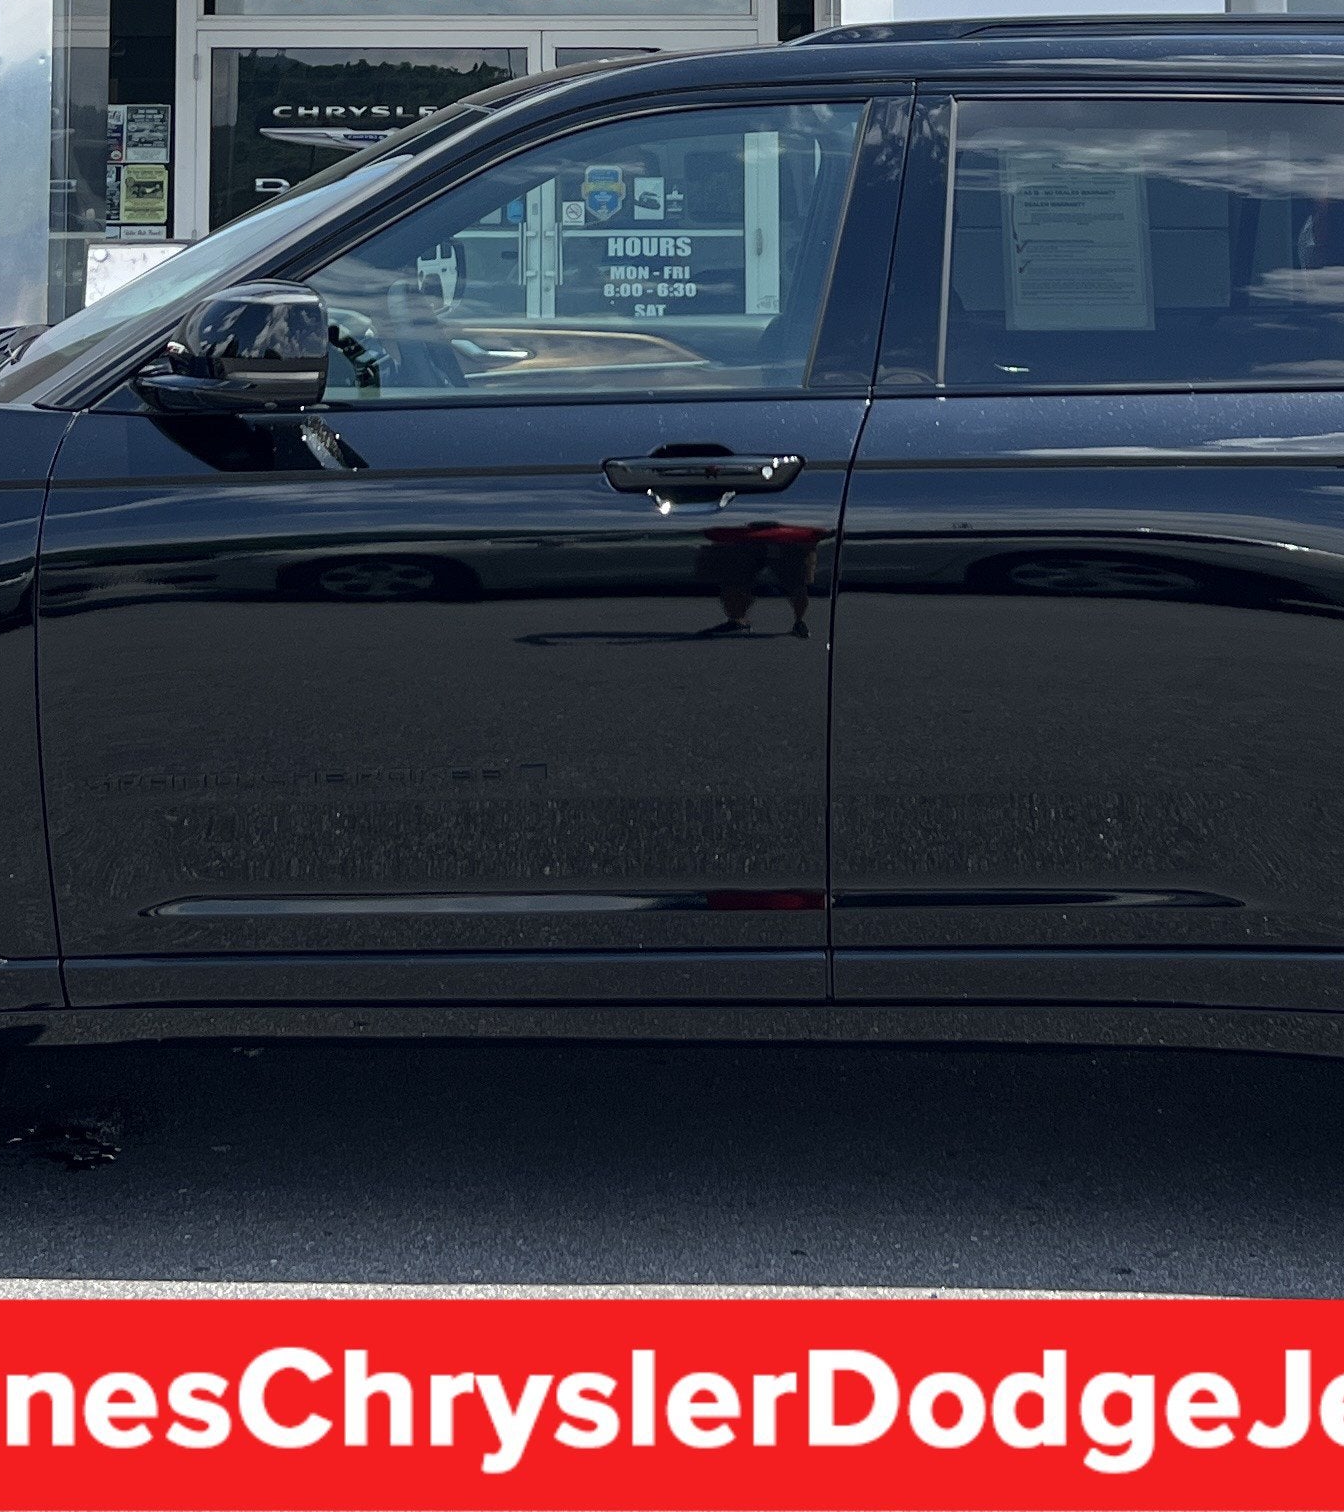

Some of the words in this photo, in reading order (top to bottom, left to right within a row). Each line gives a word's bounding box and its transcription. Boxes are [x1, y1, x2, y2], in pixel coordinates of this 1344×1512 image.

[272, 106, 439, 118] CHRYSLE
[608, 237, 692, 257] HOURS
[610, 266, 650, 280] MON
[663, 266, 691, 280] FRI
[604, 283, 643, 297] 8:00
[657, 283, 697, 297] 6:30
[634, 304, 666, 317] SAT
